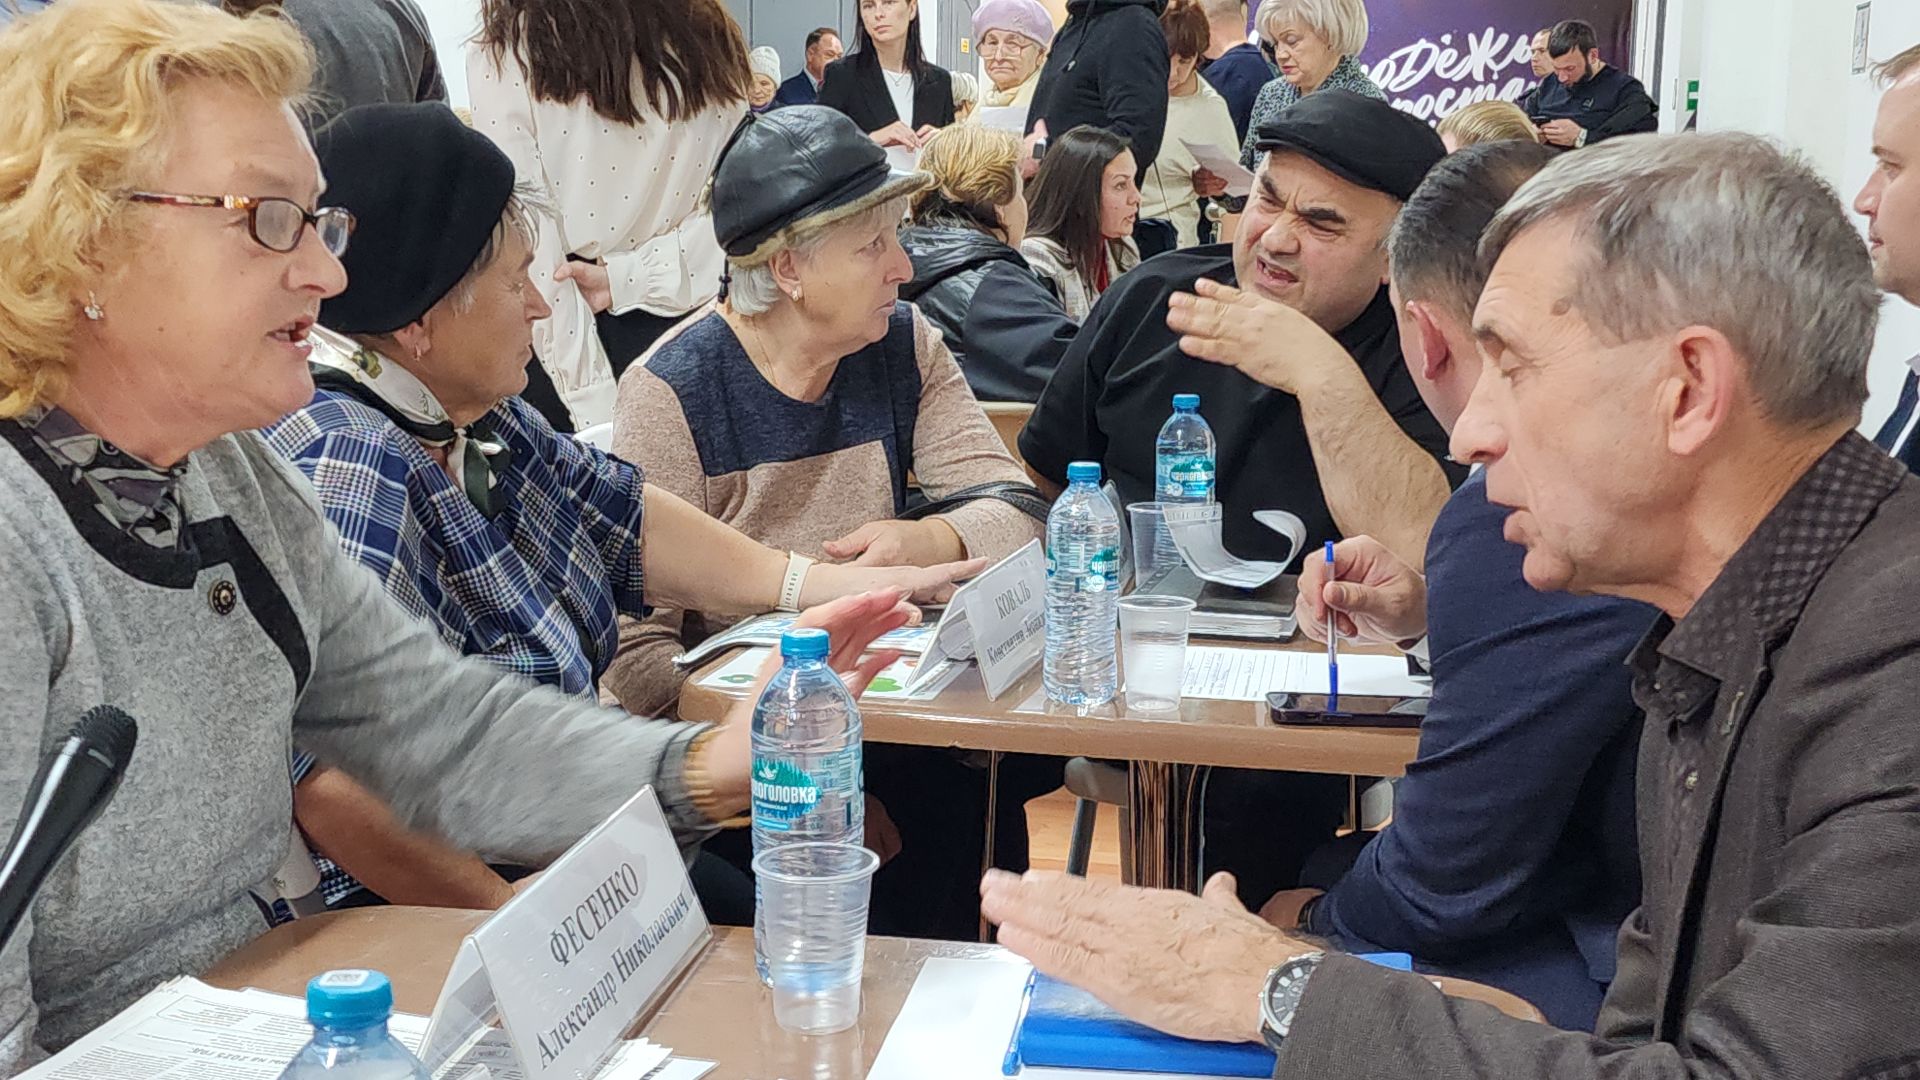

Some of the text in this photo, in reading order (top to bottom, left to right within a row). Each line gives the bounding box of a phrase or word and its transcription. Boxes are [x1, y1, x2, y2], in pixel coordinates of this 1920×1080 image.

[994, 579, 1031, 620] КОВАЛЬ
[549, 862, 640, 968] ФЕСЕНКО
[536, 891, 690, 1071] Александр Николаевич
